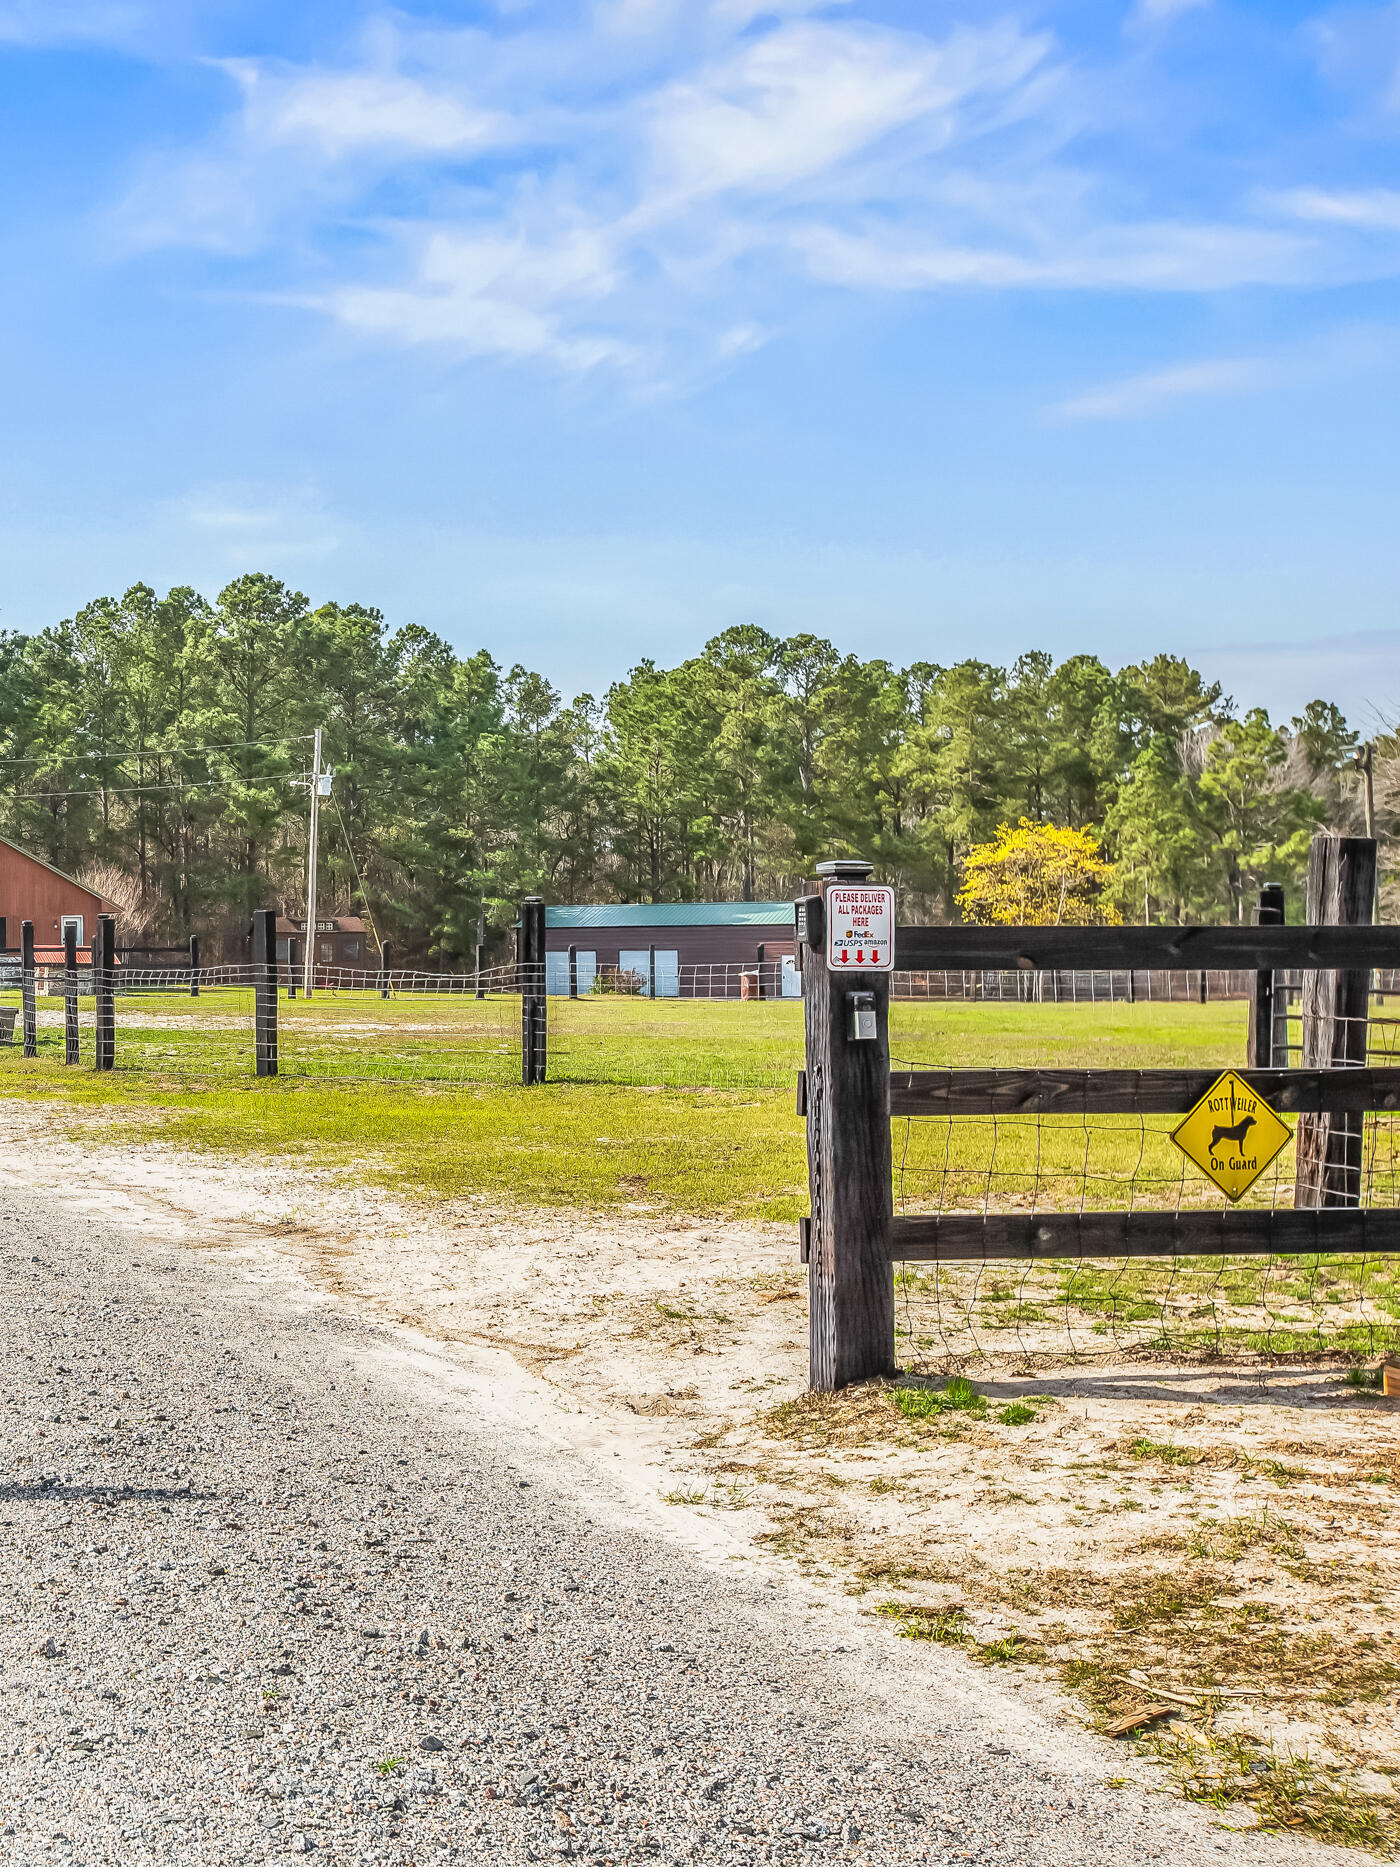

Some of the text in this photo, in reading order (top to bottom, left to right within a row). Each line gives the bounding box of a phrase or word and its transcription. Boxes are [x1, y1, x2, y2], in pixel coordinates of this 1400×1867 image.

[835, 893, 885, 903] PLEASE DELIVER
[838, 905, 883, 915] ALL PACKAGES
[852, 917, 869, 927] HERE
[1208, 1097, 1258, 1114] ROTTWEILER
[1210, 1156, 1258, 1171] On Guard
